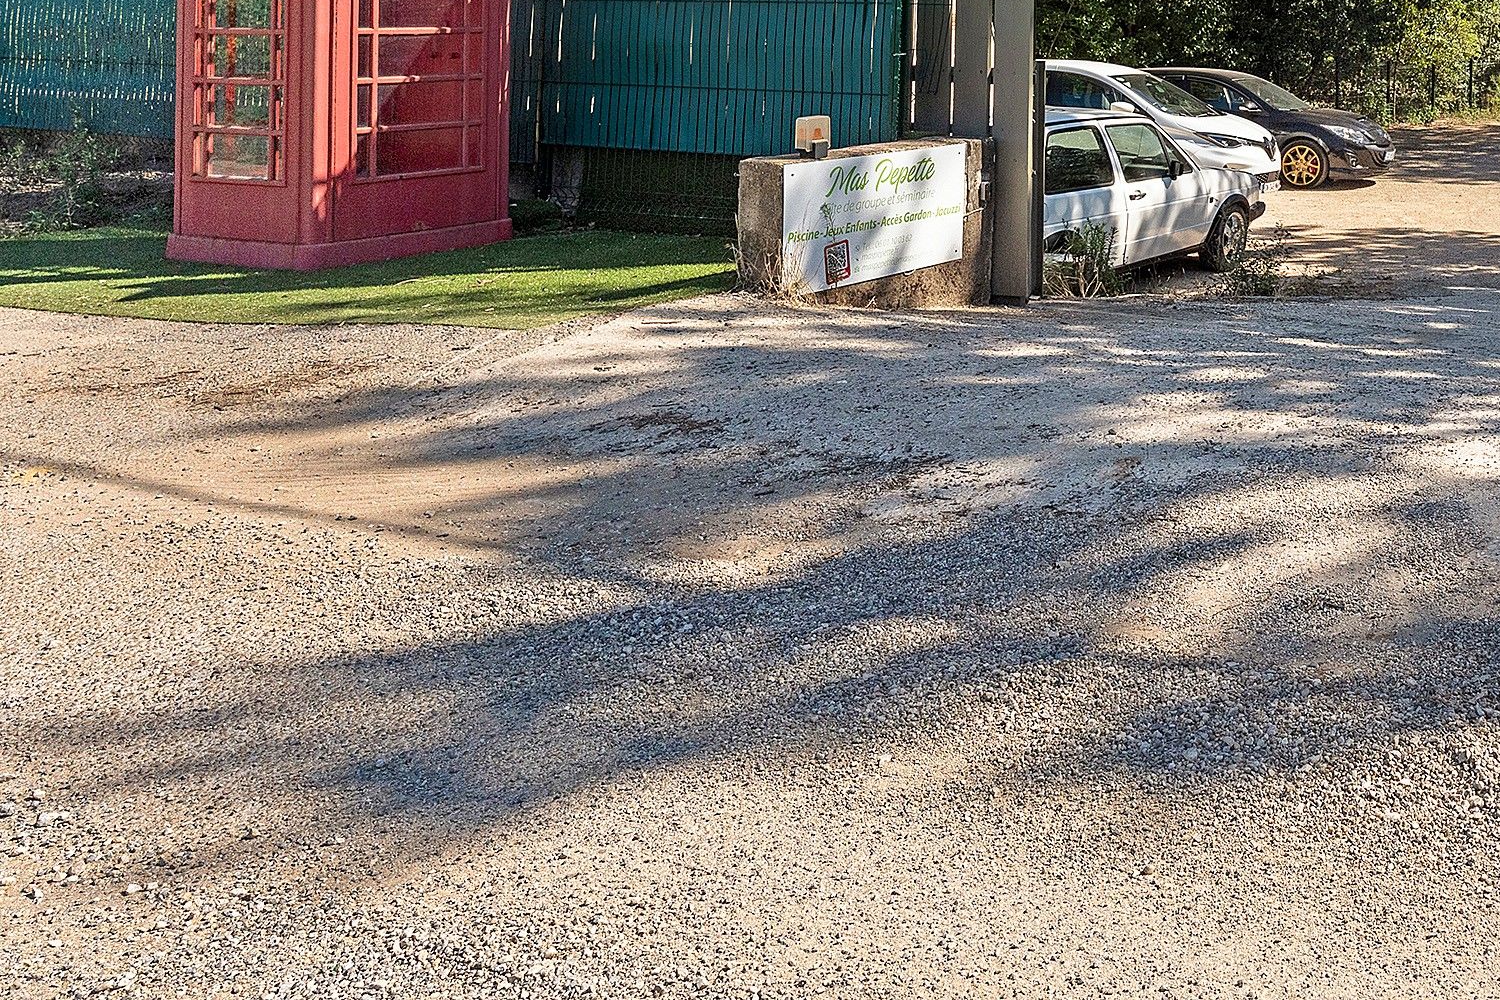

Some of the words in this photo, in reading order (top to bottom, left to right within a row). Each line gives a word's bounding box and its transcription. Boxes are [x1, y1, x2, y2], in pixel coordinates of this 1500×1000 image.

[825, 165, 870, 198] Mas
[875, 156, 936, 194] Pepette
[843, 200, 855, 213] de
[855, 195, 887, 213] groupe
[887, 195, 895, 206] et
[896, 187, 935, 204] séminaire
